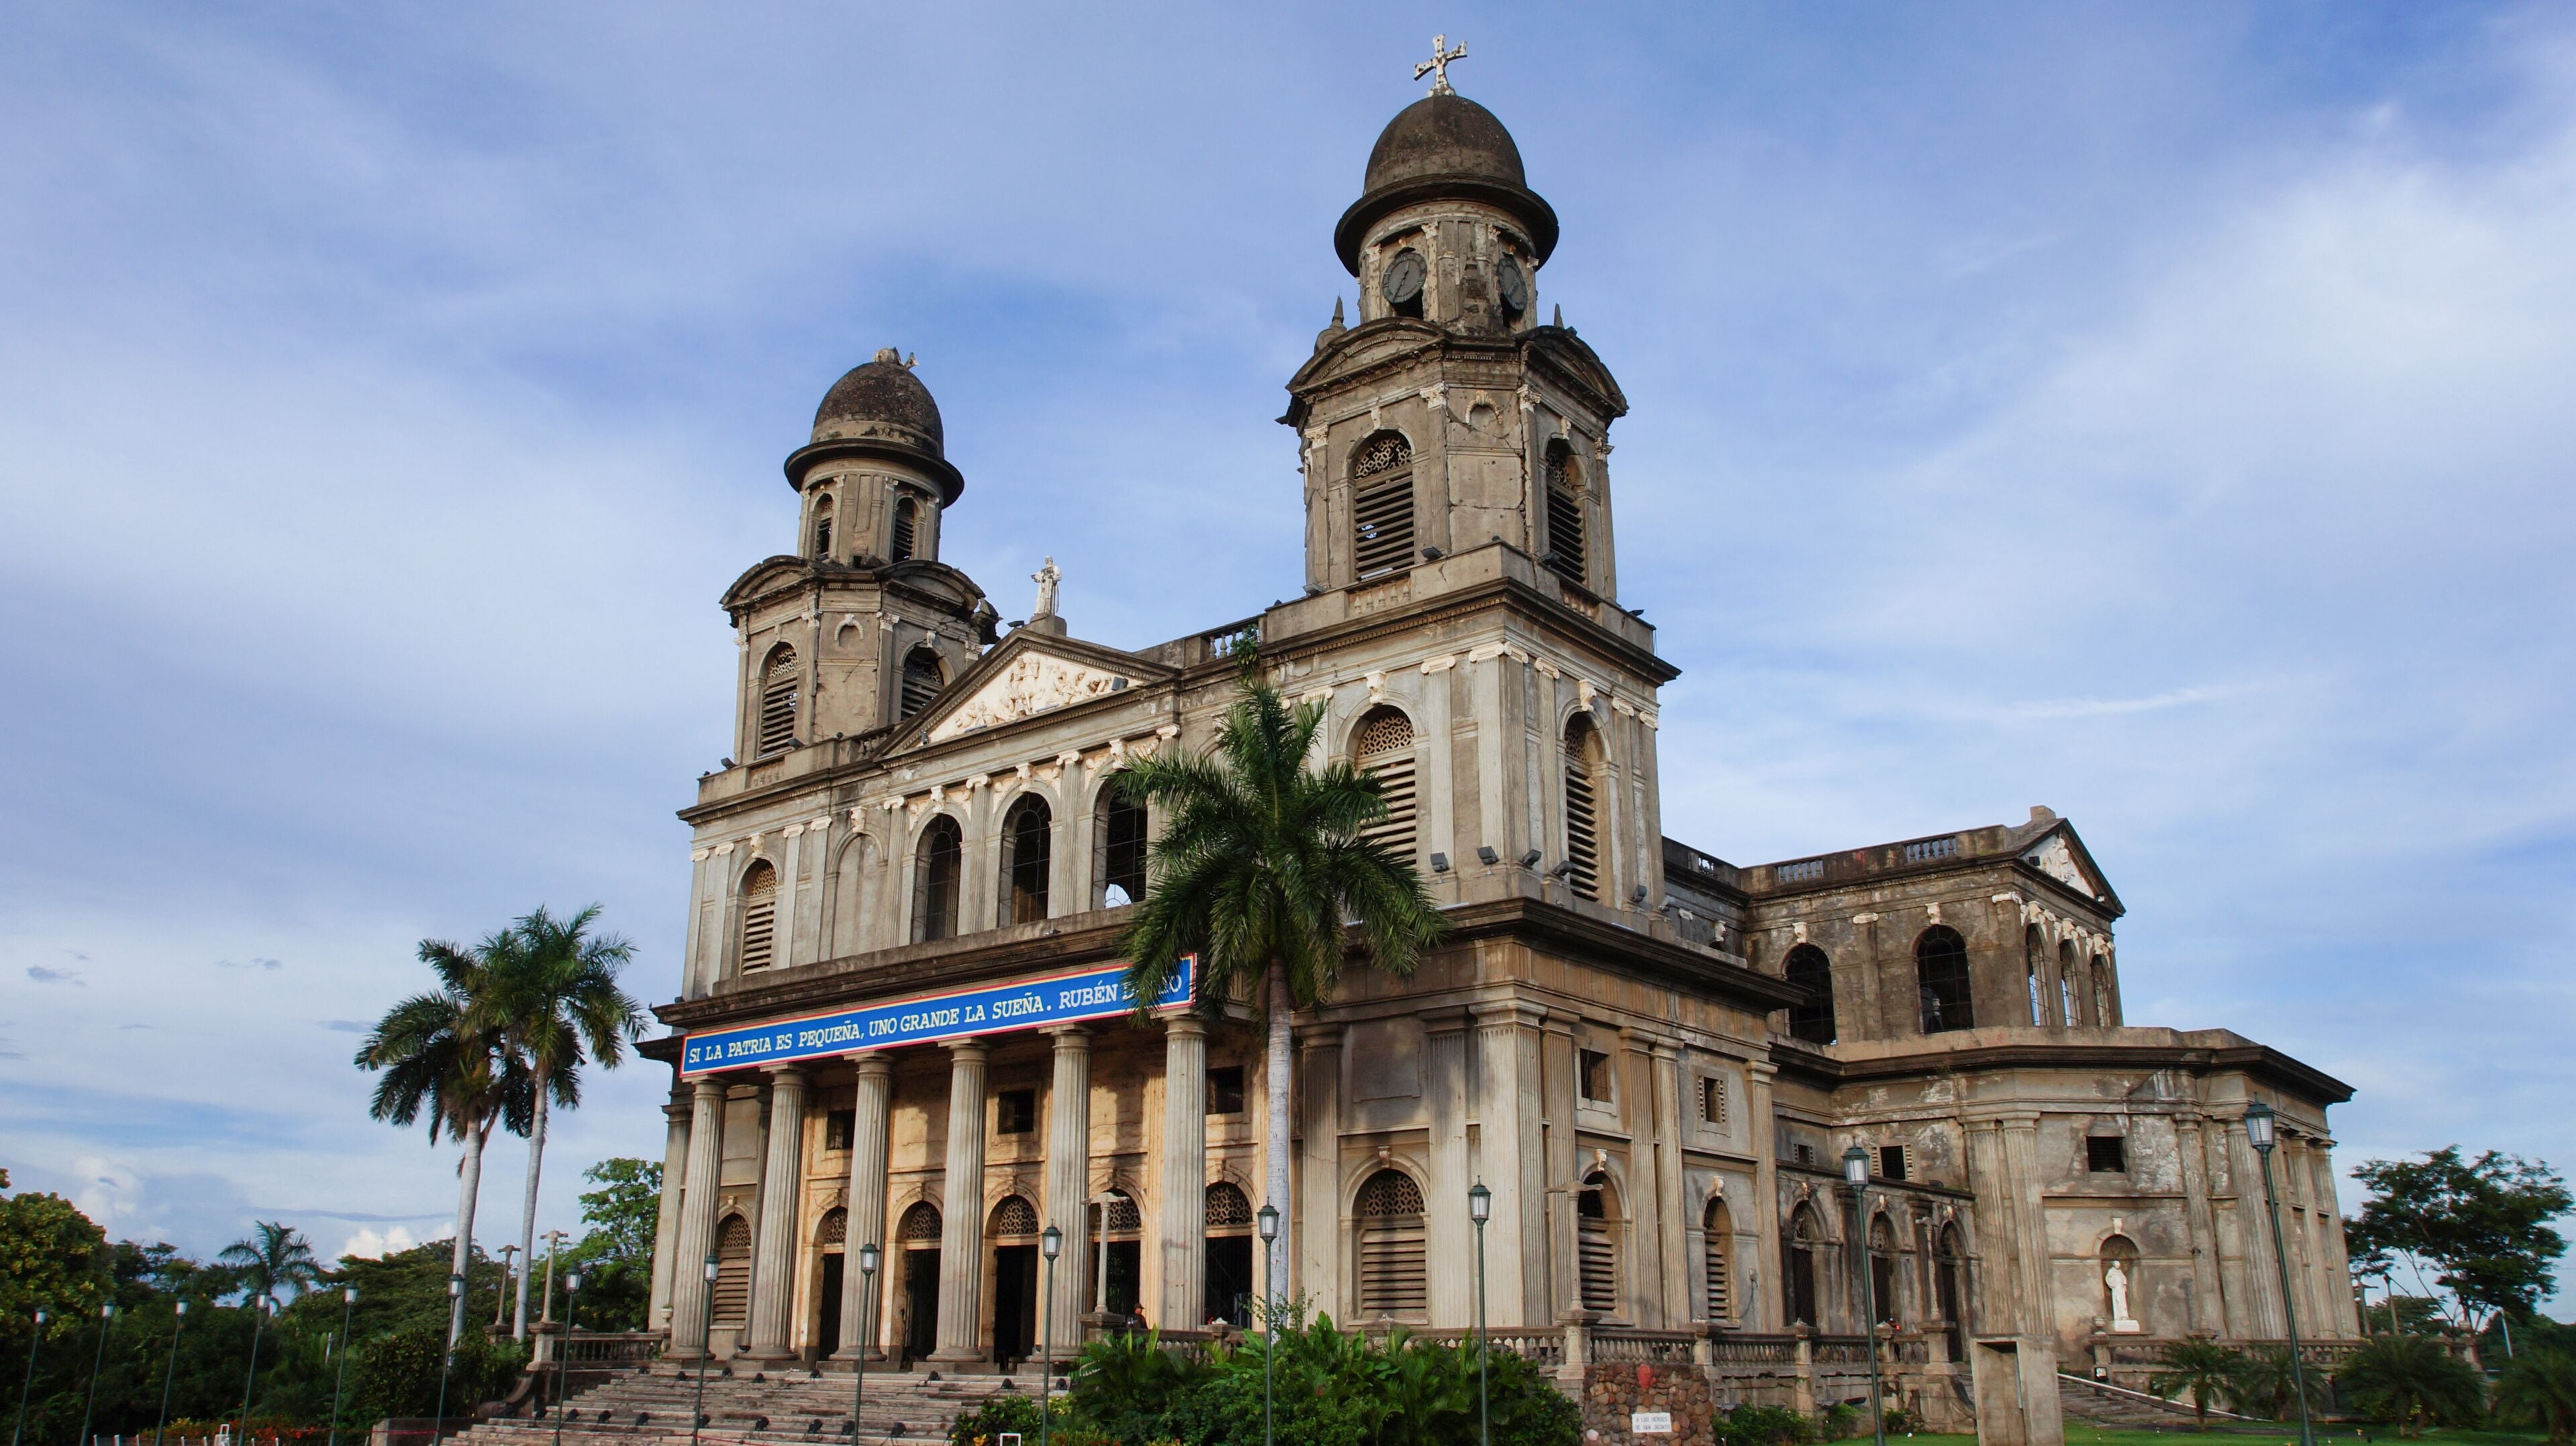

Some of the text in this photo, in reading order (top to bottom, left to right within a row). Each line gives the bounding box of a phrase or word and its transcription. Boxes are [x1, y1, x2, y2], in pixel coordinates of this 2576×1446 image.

[689, 1048, 701, 1063] SI
[705, 1045, 722, 1061] LA
[727, 1038, 771, 1057] PATRIA
[775, 1034, 792, 1050] ES
[798, 1020, 864, 1048] PEQUEÑA,
[869, 1017, 897, 1037] UNO
[900, 1008, 959, 1032] GRANDE
[964, 1005, 985, 1023] LA
[992, 993, 1051, 1019] SUEÑA.
[1059, 980, 1118, 1009] RUBÉN
